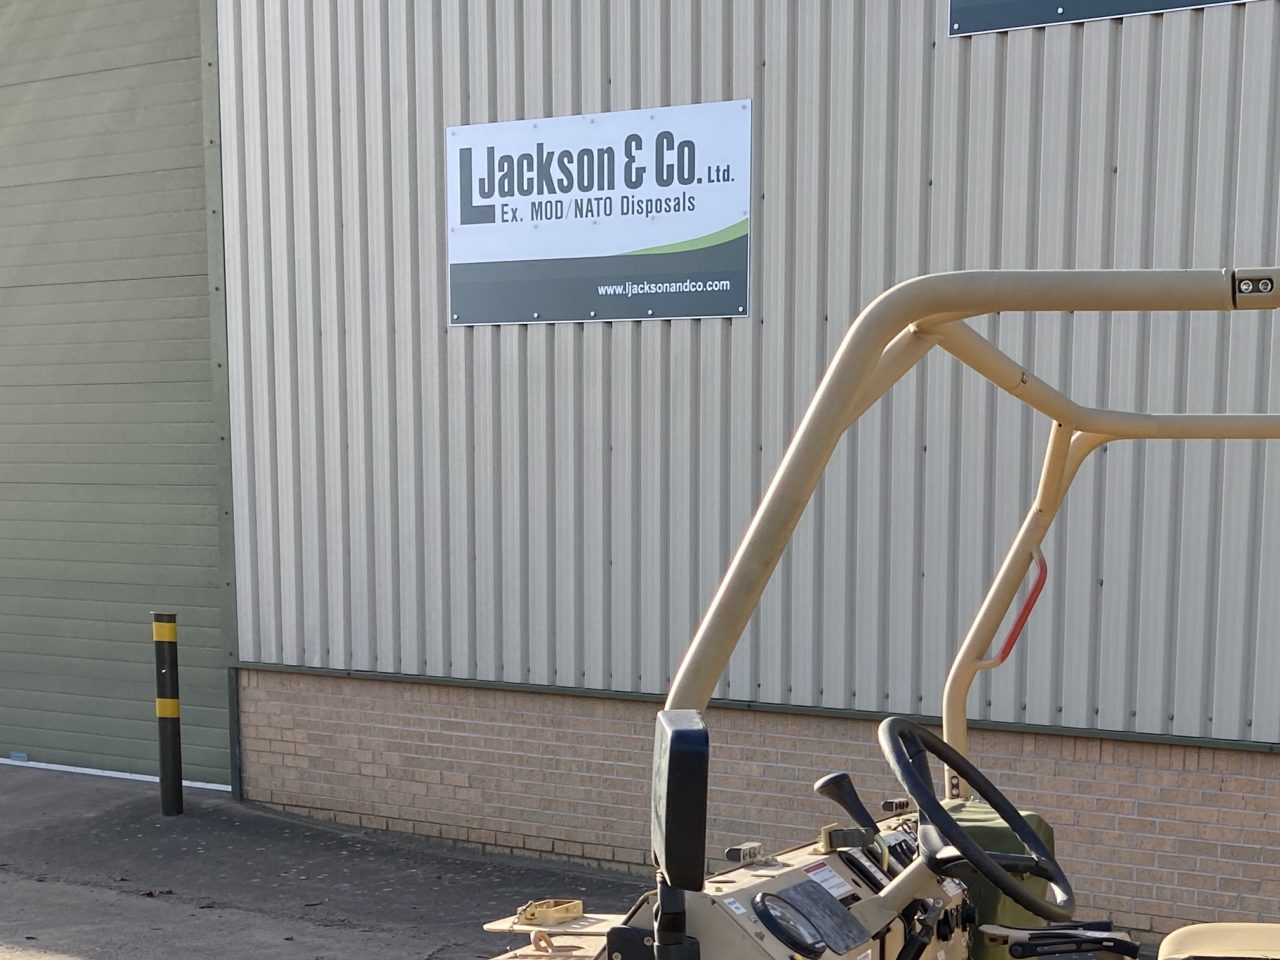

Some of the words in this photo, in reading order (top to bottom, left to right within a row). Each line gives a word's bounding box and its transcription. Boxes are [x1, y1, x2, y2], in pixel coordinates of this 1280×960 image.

[624, 133, 646, 189] &
[655, 130, 703, 187] Co.
[707, 165, 735, 183] Ltd.
[500, 203, 524, 223] Ex.
[530, 196, 613, 221] MOD/NATO
[620, 192, 696, 216] Disposals
[597, 279, 731, 297] www.ljacksonandco.com
